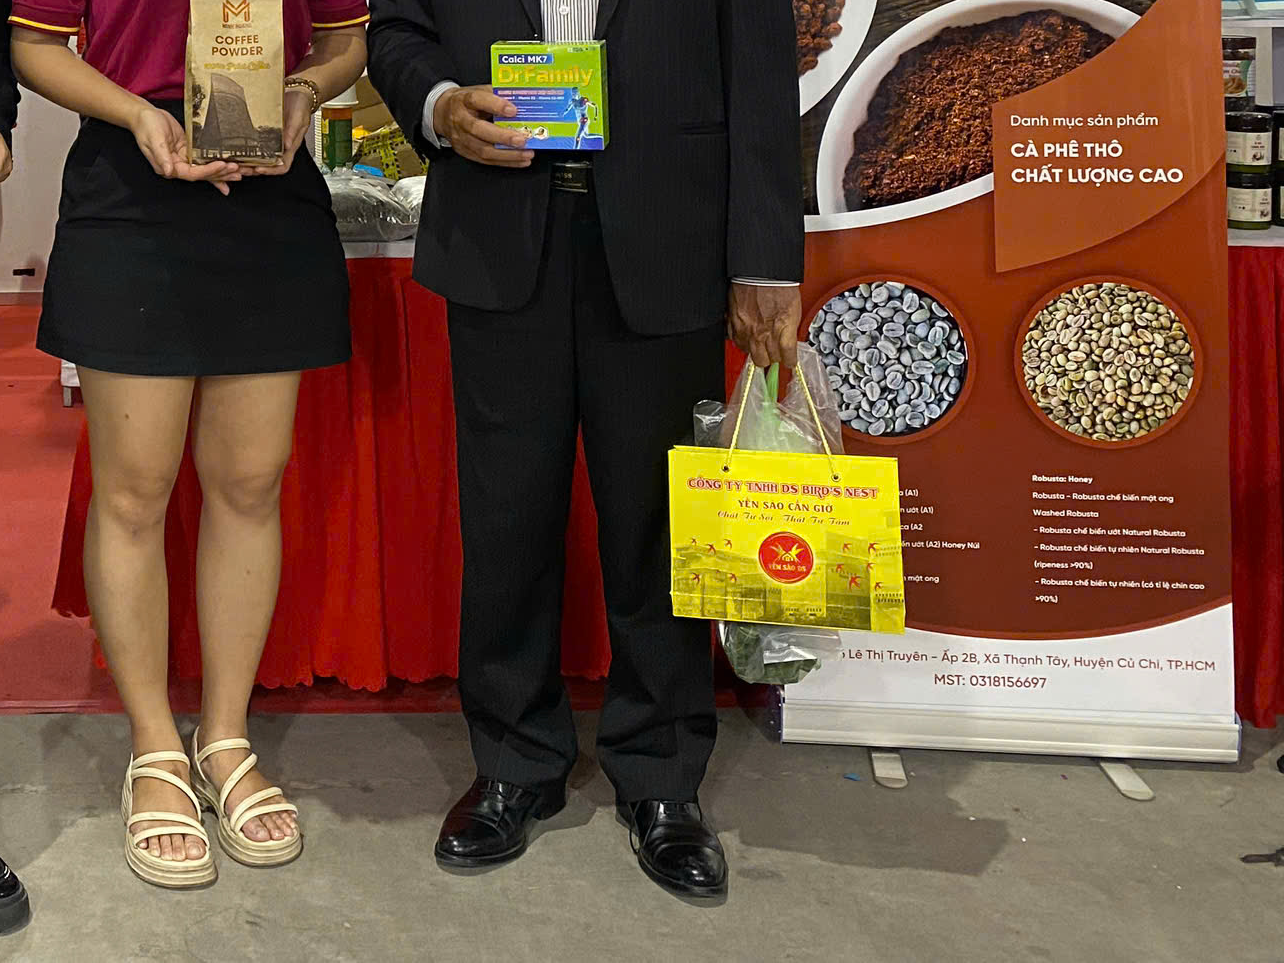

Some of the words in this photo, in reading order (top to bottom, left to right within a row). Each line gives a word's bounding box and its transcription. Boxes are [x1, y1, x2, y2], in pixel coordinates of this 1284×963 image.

[215, 34, 259, 46] COFFEE
[211, 46, 264, 57] POWDER
[501, 55, 525, 64] Calci
[527, 55, 548, 64] MK7
[497, 65, 594, 86] DrFamily
[1010, 114, 1049, 127] Danh
[1052, 116, 1084, 129] mục
[1087, 114, 1113, 127] sản
[1116, 112, 1159, 128] phẩm
[1010, 140, 1039, 158] CÀ
[1043, 140, 1080, 158] PHÊ
[1083, 140, 1123, 158] THÔ
[1011, 164, 1063, 183] CHẤT
[1068, 167, 1135, 187] LƯỢNG
[1138, 167, 1184, 183] CAO
[1068, 475, 1093, 485] Honey
[687, 477, 722, 490] CÔNG
[724, 479, 742, 491] TY
[746, 481, 778, 493] TNHH
[781, 483, 799, 495] DS
[802, 484, 842, 499] BIRD'S
[844, 487, 878, 499] NEST
[1032, 492, 1065, 500] Robusta
[1072, 492, 1105, 501] Robusta
[1158, 495, 1174, 504] ong
[1033, 509, 1065, 517] Washed
[1066, 509, 1099, 518] Robusta
[1039, 526, 1072, 535] Robusta
[1122, 528, 1152, 537] Natural
[1153, 529, 1186, 538] Robusta
[1040, 543, 1072, 552] Robusta
[1141, 546, 1170, 555] Natural
[1171, 547, 1205, 555] Robusta
[1034, 560, 1069, 570] (ripeness
[1040, 578, 1073, 587] Robusta
[848, 649, 863, 660] Lê
[866, 649, 884, 663] Thị
[887, 650, 928, 664] Truyên
[941, 649, 959, 664] Ấp
[961, 652, 980, 665] 2B,
[984, 653, 1001, 664] Xã
[1004, 654, 1043, 667] Thạnh
[1046, 655, 1070, 668] Tây,
[1073, 656, 1114, 670] Huyện
[1117, 657, 1135, 669] Củ
[1138, 658, 1163, 671] Chi,
[1166, 659, 1216, 671] TP.HCM
[934, 674, 966, 686] MST:
[969, 675, 1047, 689] 0318156697
